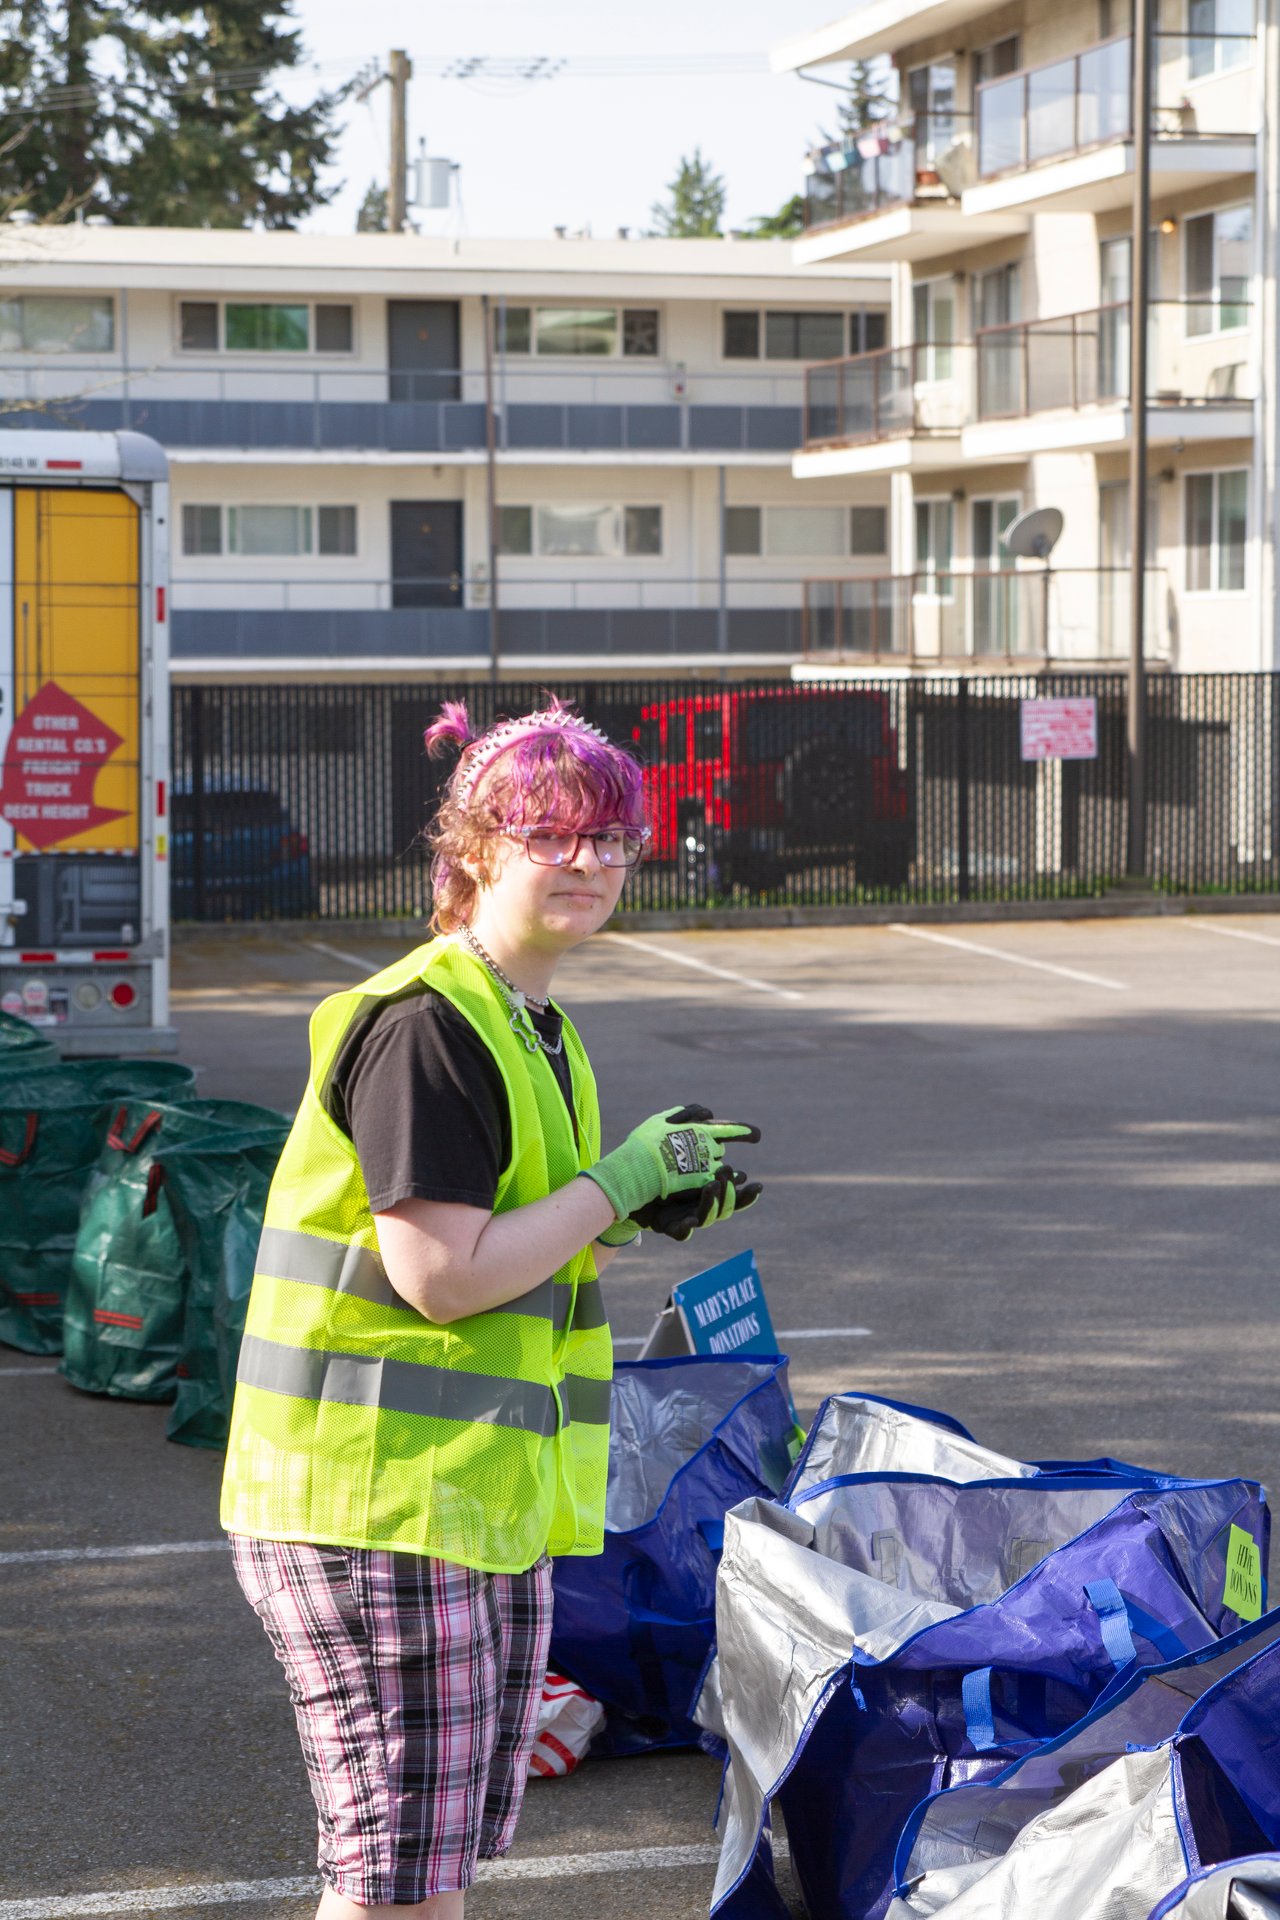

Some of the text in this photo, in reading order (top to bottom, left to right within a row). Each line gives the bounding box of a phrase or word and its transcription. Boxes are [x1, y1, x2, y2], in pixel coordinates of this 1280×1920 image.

[33, 716, 79, 731] OTHER
[17, 738, 68, 753] RENTAL
[22, 760, 80, 775] FREIGHT
[25, 782, 71, 797] TRUCK
[4, 804, 89, 820] DECK HEIGHT
[693, 1275, 757, 1328] MARY'S PLACE
[709, 1312, 760, 1354] DONATIONS
